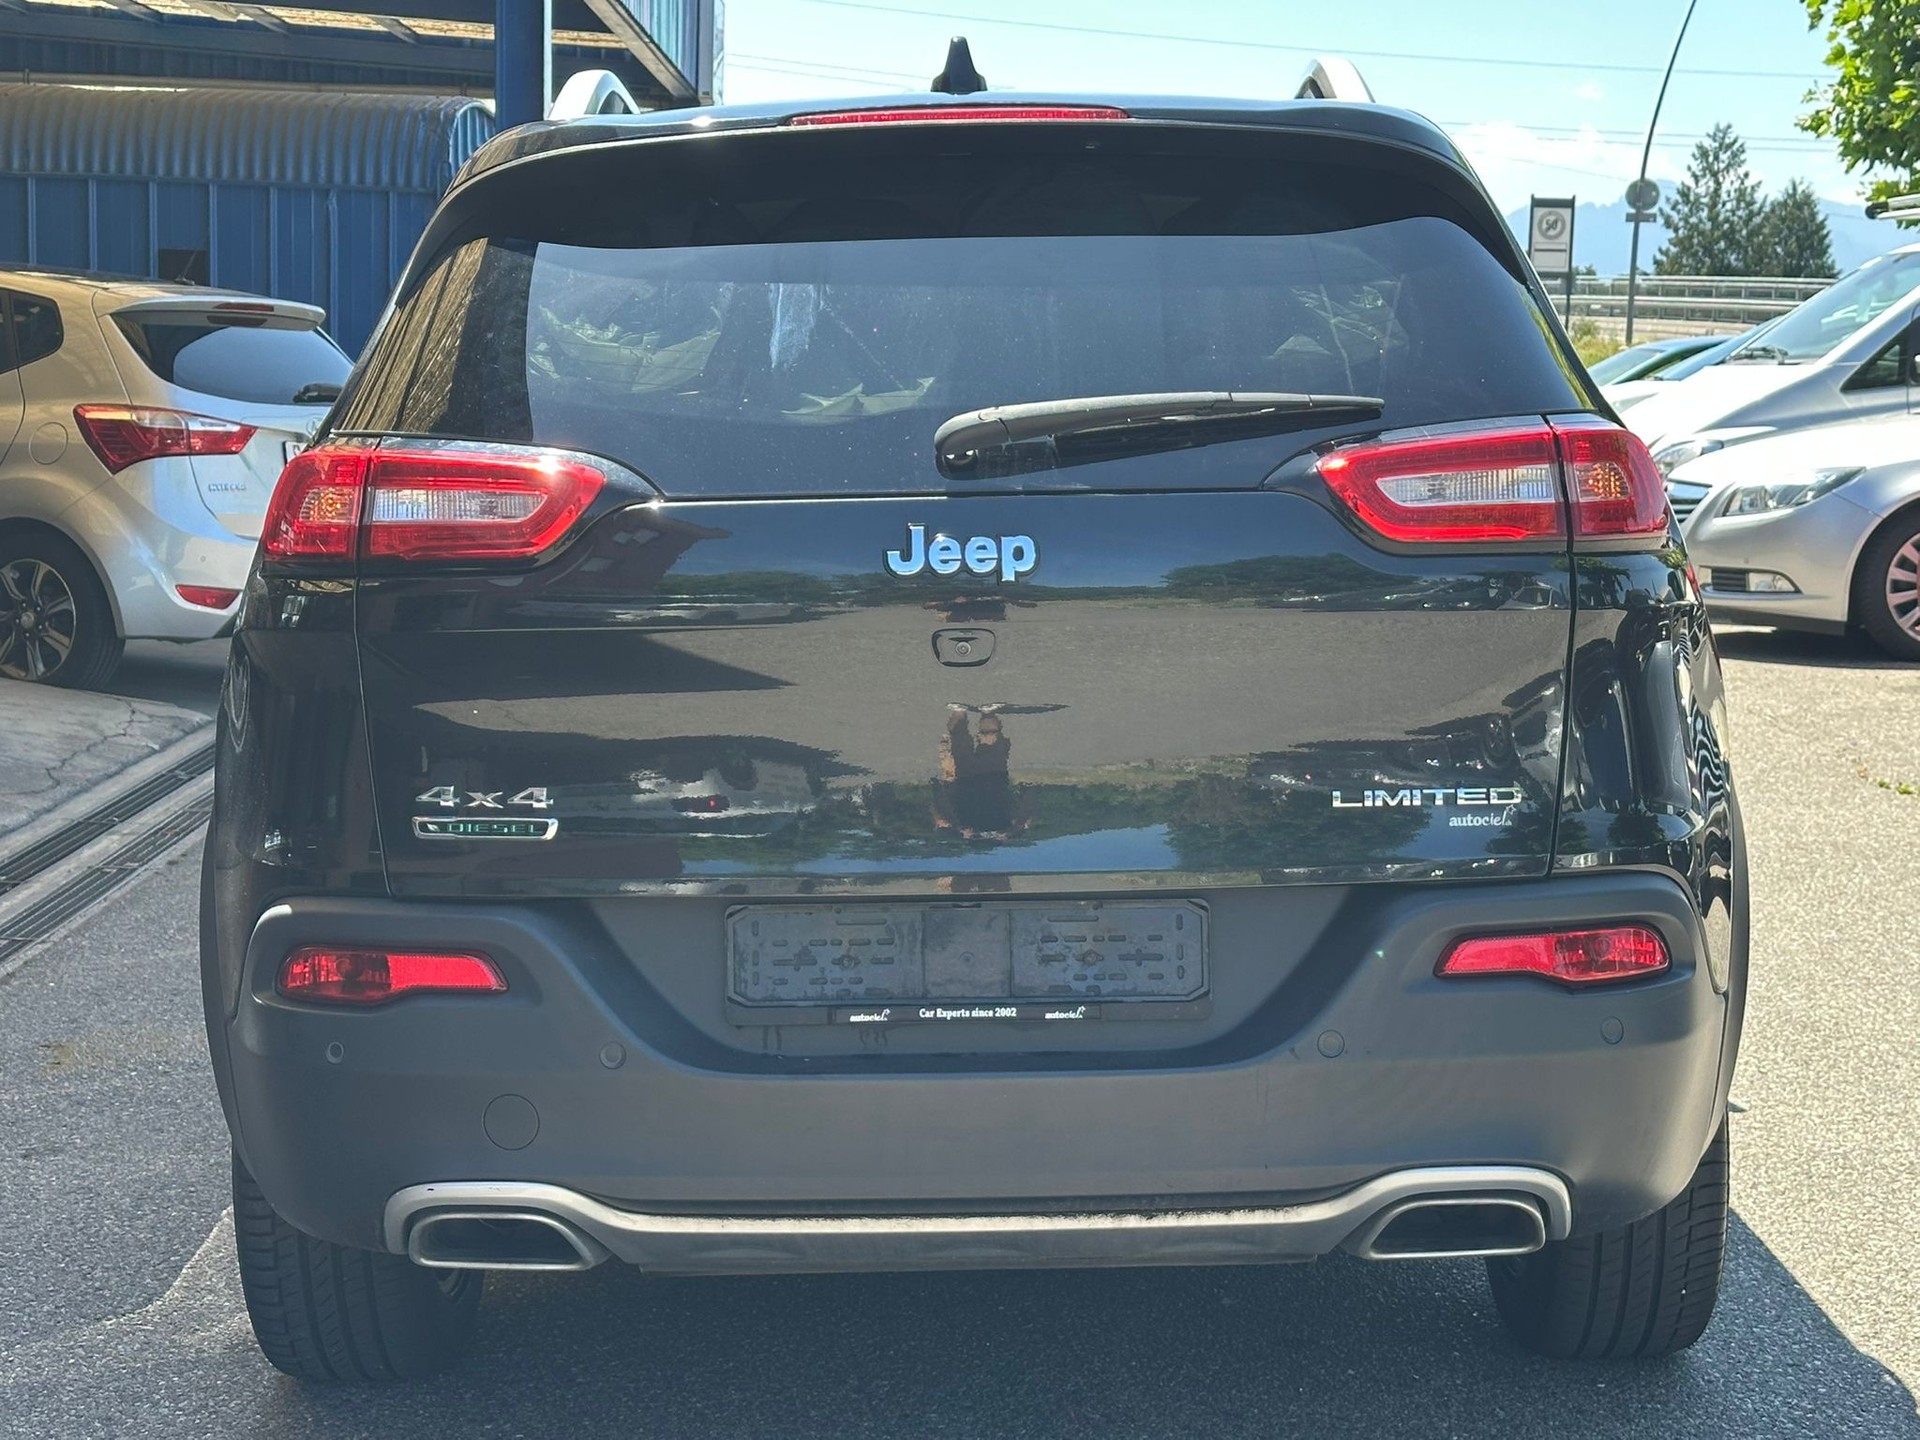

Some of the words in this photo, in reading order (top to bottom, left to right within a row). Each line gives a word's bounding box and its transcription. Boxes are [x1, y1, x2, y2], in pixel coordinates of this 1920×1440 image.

[886, 523, 1036, 582] Jeep
[415, 785, 554, 808] 4x4
[1332, 786, 1522, 808] LIMITED
[447, 823, 544, 833] DIESEL
[919, 1008, 934, 1018] Car
[936, 1007, 970, 1020] Experts
[971, 1007, 994, 1017] since
[995, 1007, 1017, 1017] 2002
